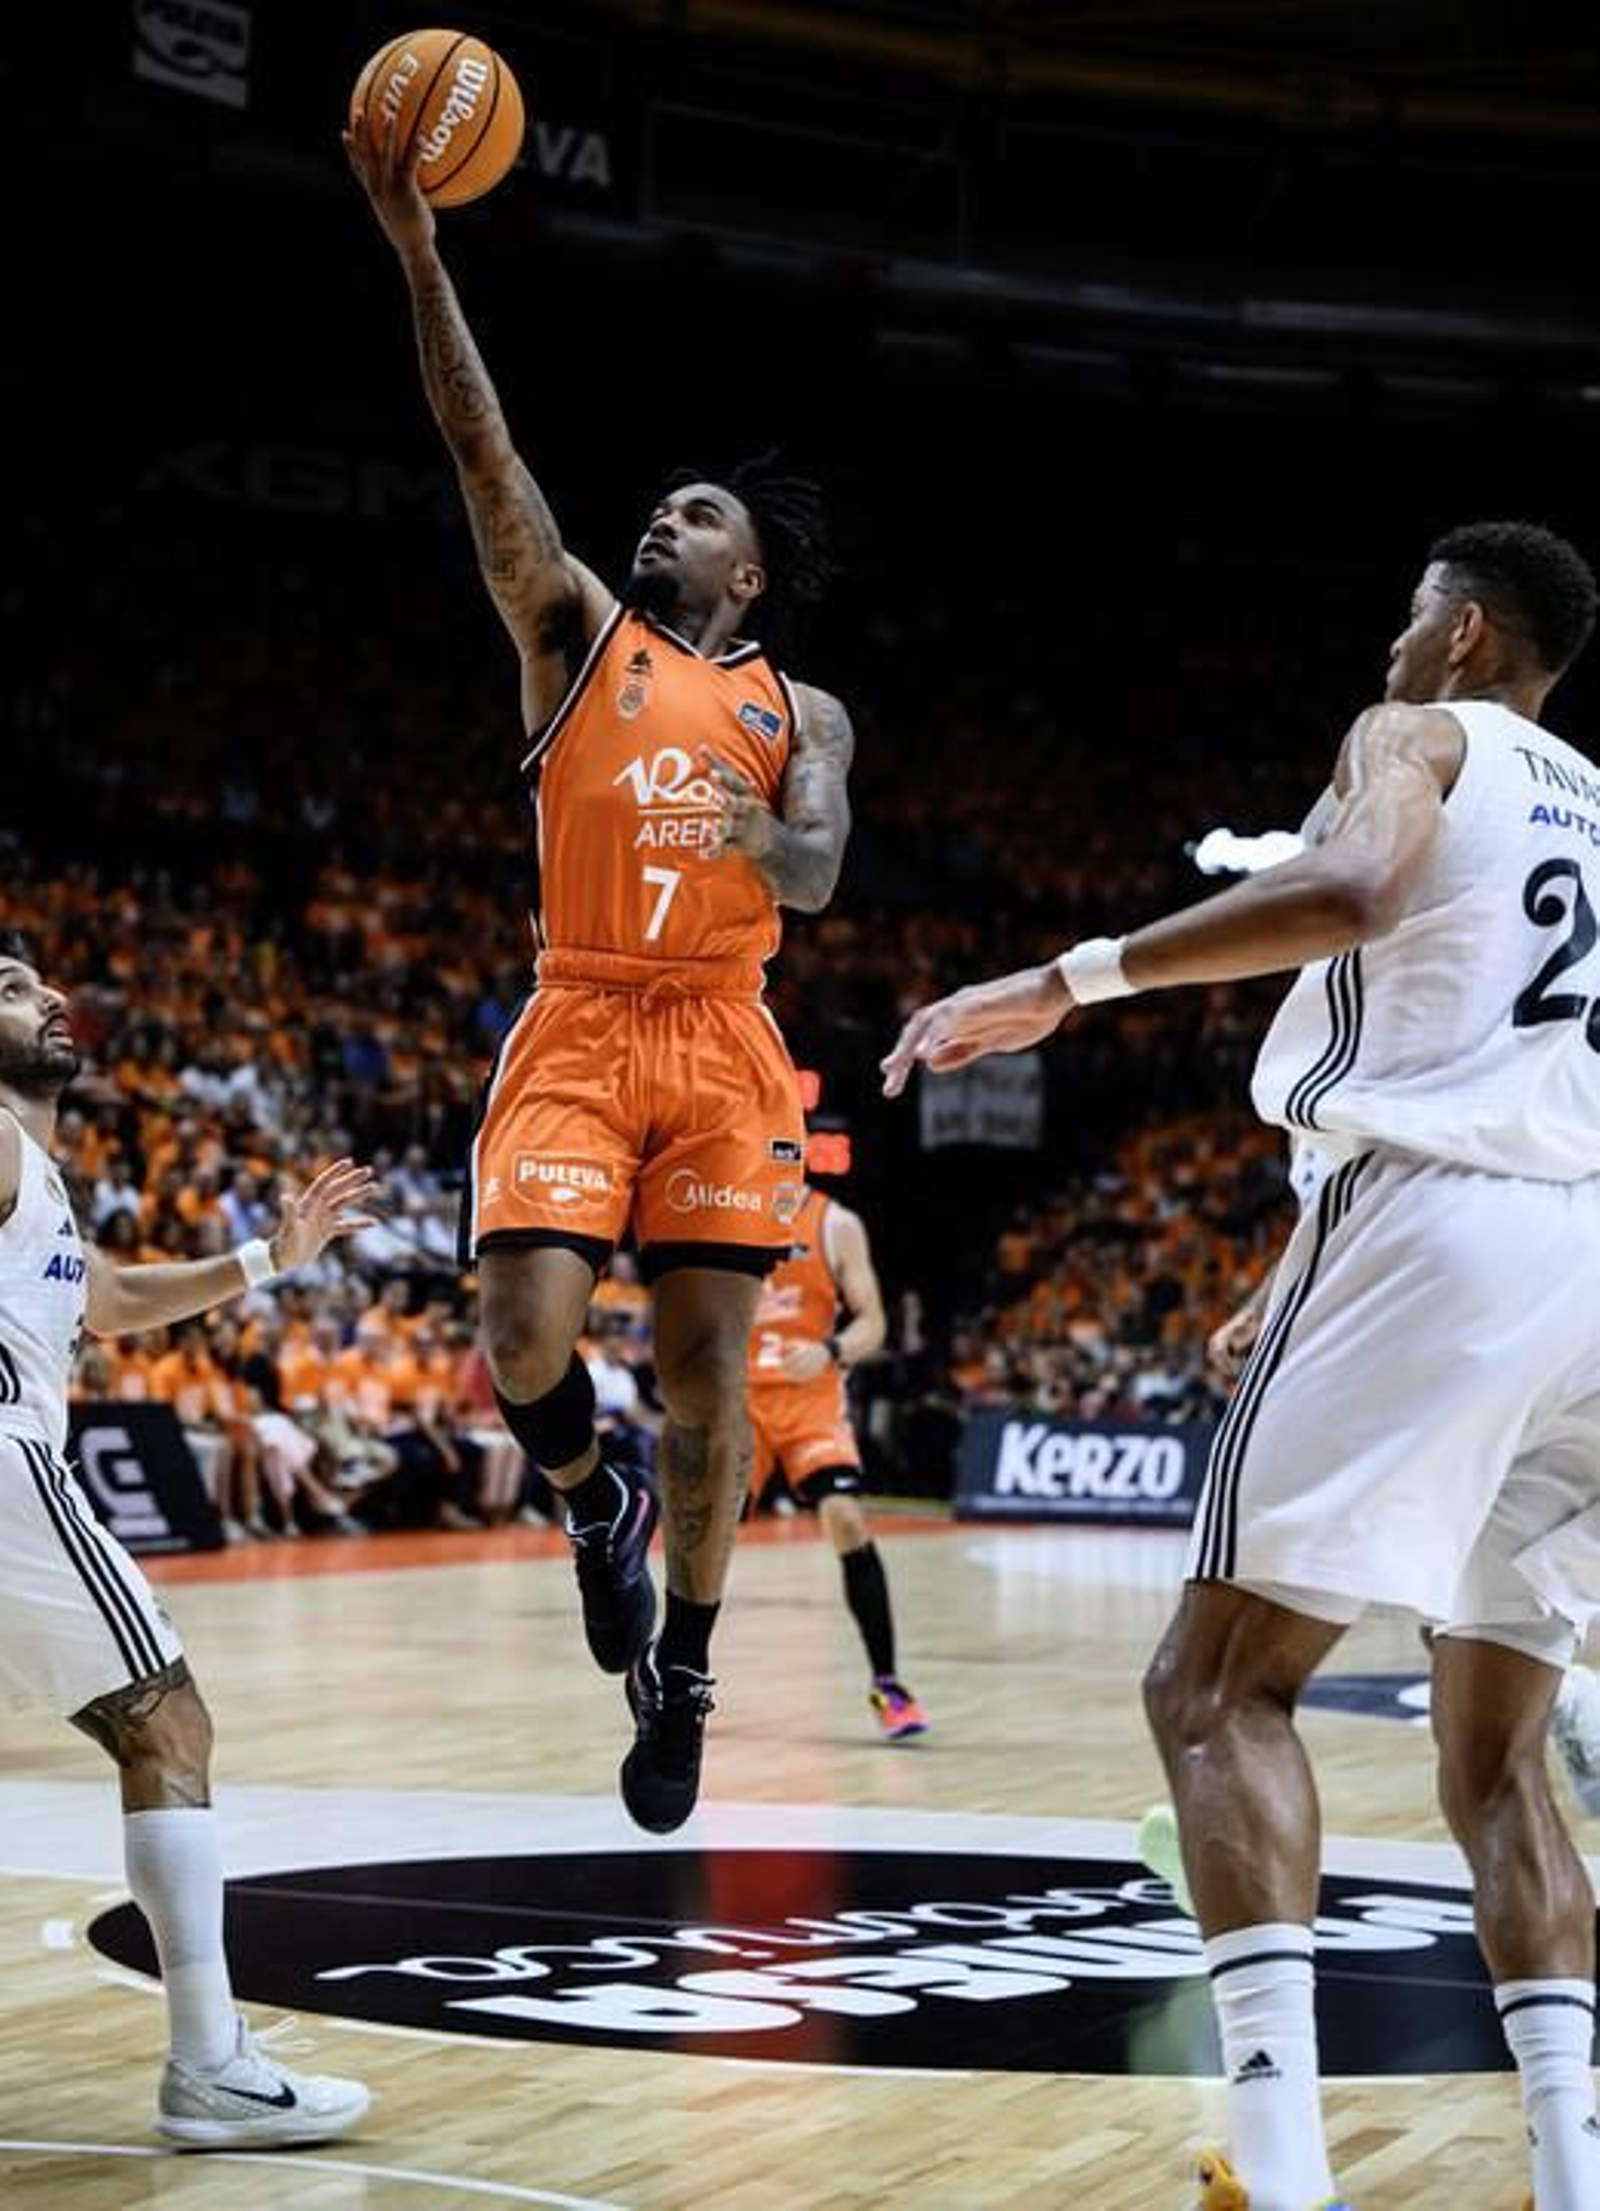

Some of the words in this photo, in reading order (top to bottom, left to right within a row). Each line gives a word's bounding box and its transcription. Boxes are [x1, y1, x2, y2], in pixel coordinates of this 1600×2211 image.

[418, 57, 488, 163] Wilson
[534, 120, 611, 188] VA
[642, 865, 682, 941] 7
[1513, 858, 1600, 1054] 2
[517, 1160, 612, 1191] PULEVA
[684, 1182, 762, 1211] Midea
